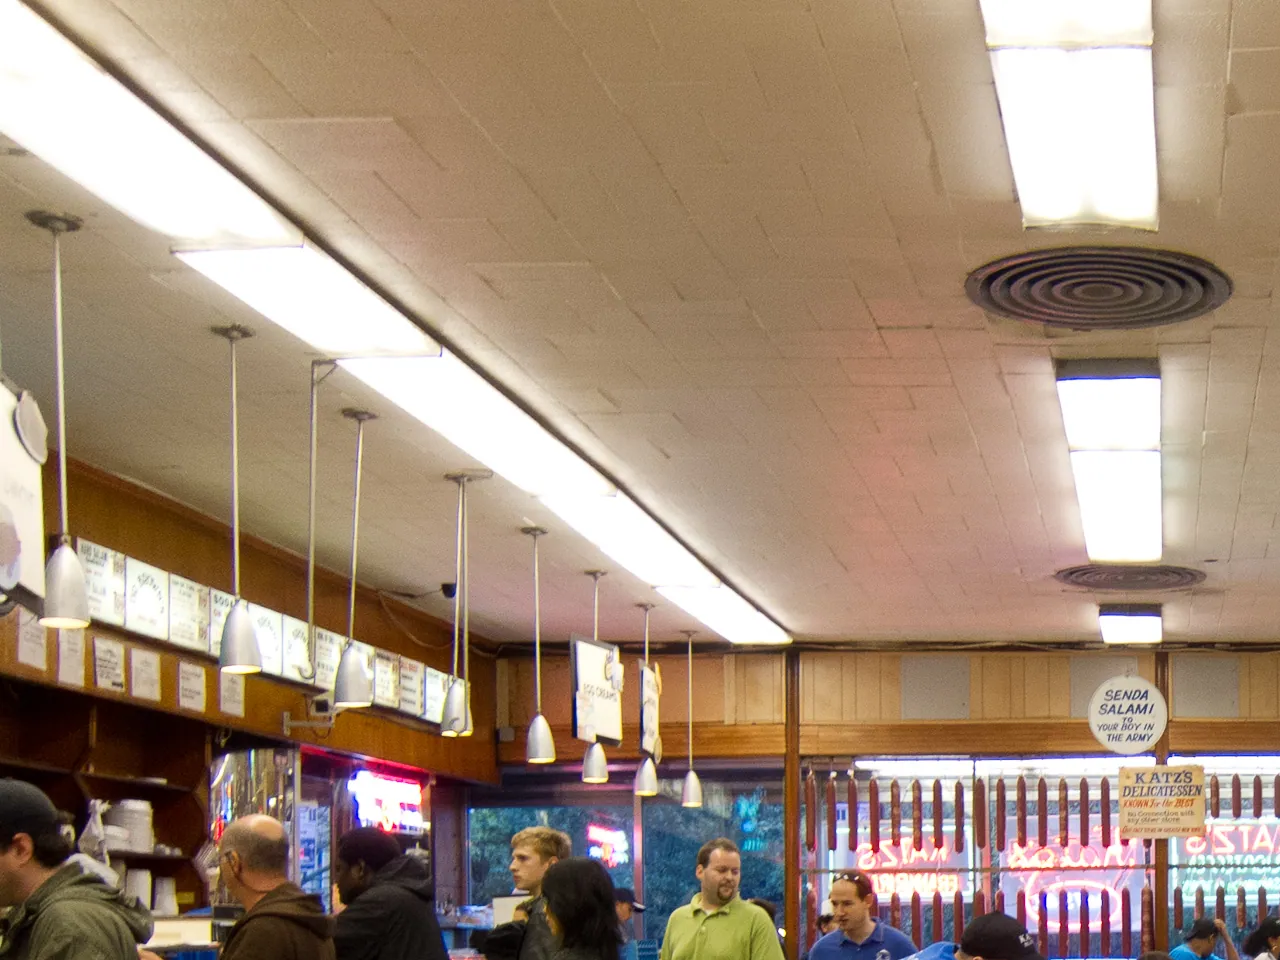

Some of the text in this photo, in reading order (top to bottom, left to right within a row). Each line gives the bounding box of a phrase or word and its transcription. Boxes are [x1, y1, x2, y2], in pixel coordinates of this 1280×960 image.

[1098, 703, 1155, 715] SALAMI
[1107, 734, 1153, 742] THE ARMY
[1135, 770, 1193, 784] KATZ'S
[1122, 784, 1203, 797] DELICATESSEN
[1174, 799, 1195, 808] BEST
